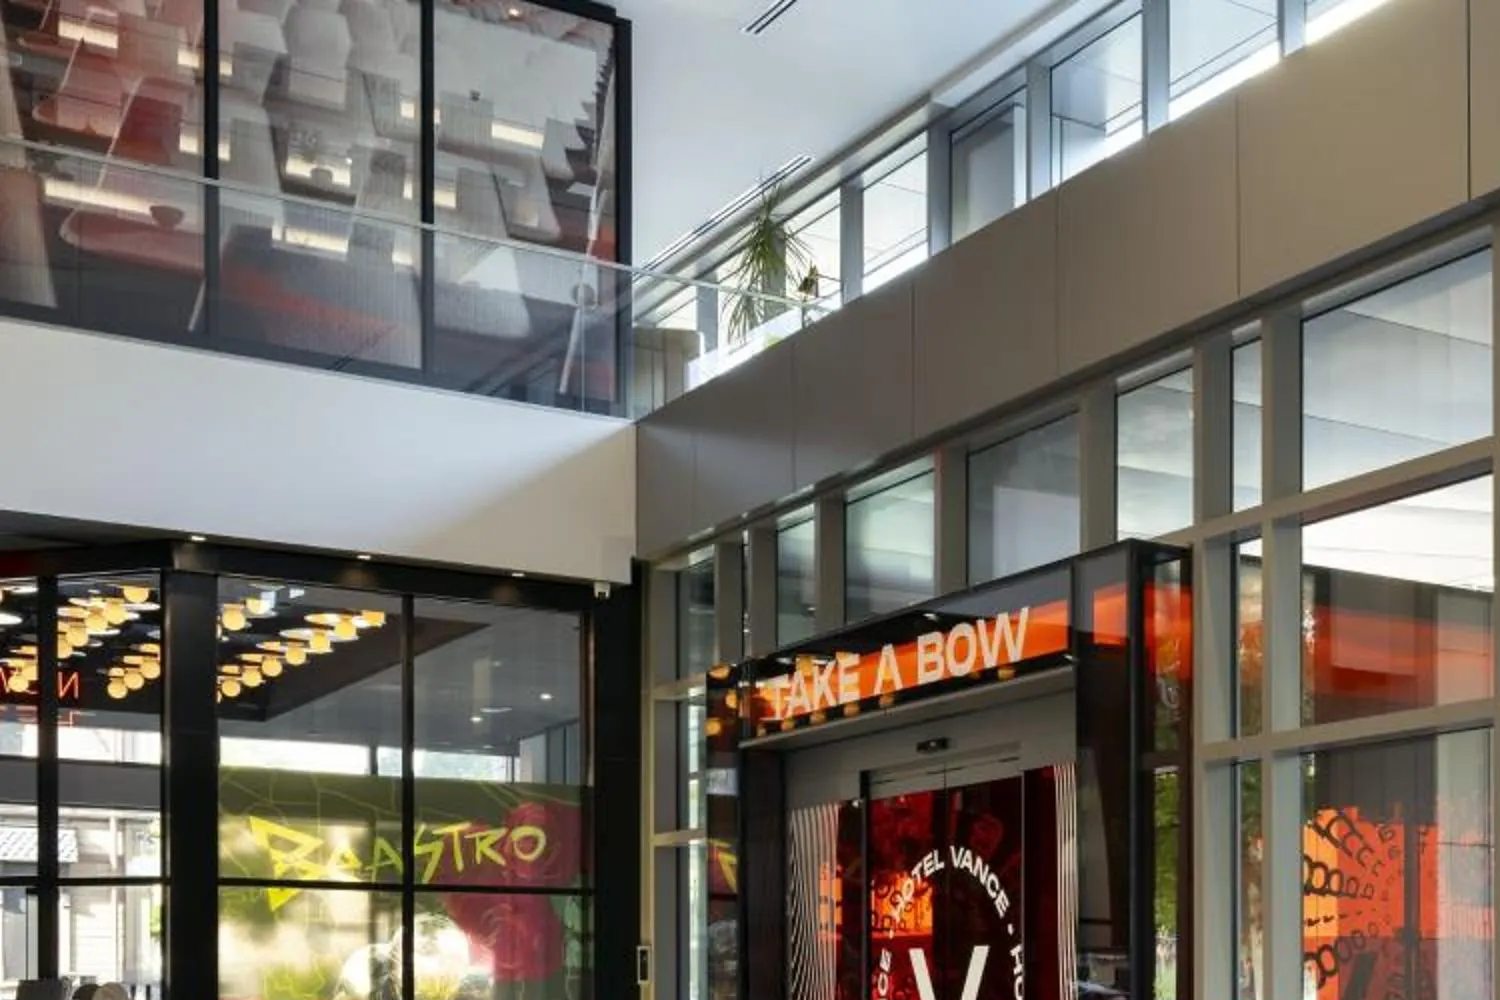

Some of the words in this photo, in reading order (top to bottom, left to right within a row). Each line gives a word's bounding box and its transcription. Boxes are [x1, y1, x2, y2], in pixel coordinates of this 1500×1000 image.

[766, 652, 860, 721] TAKE
[873, 643, 902, 695] A
[917, 606, 1029, 684] BOW
[889, 849, 945, 923] HOTEL
[949, 844, 1010, 919] VANCE
